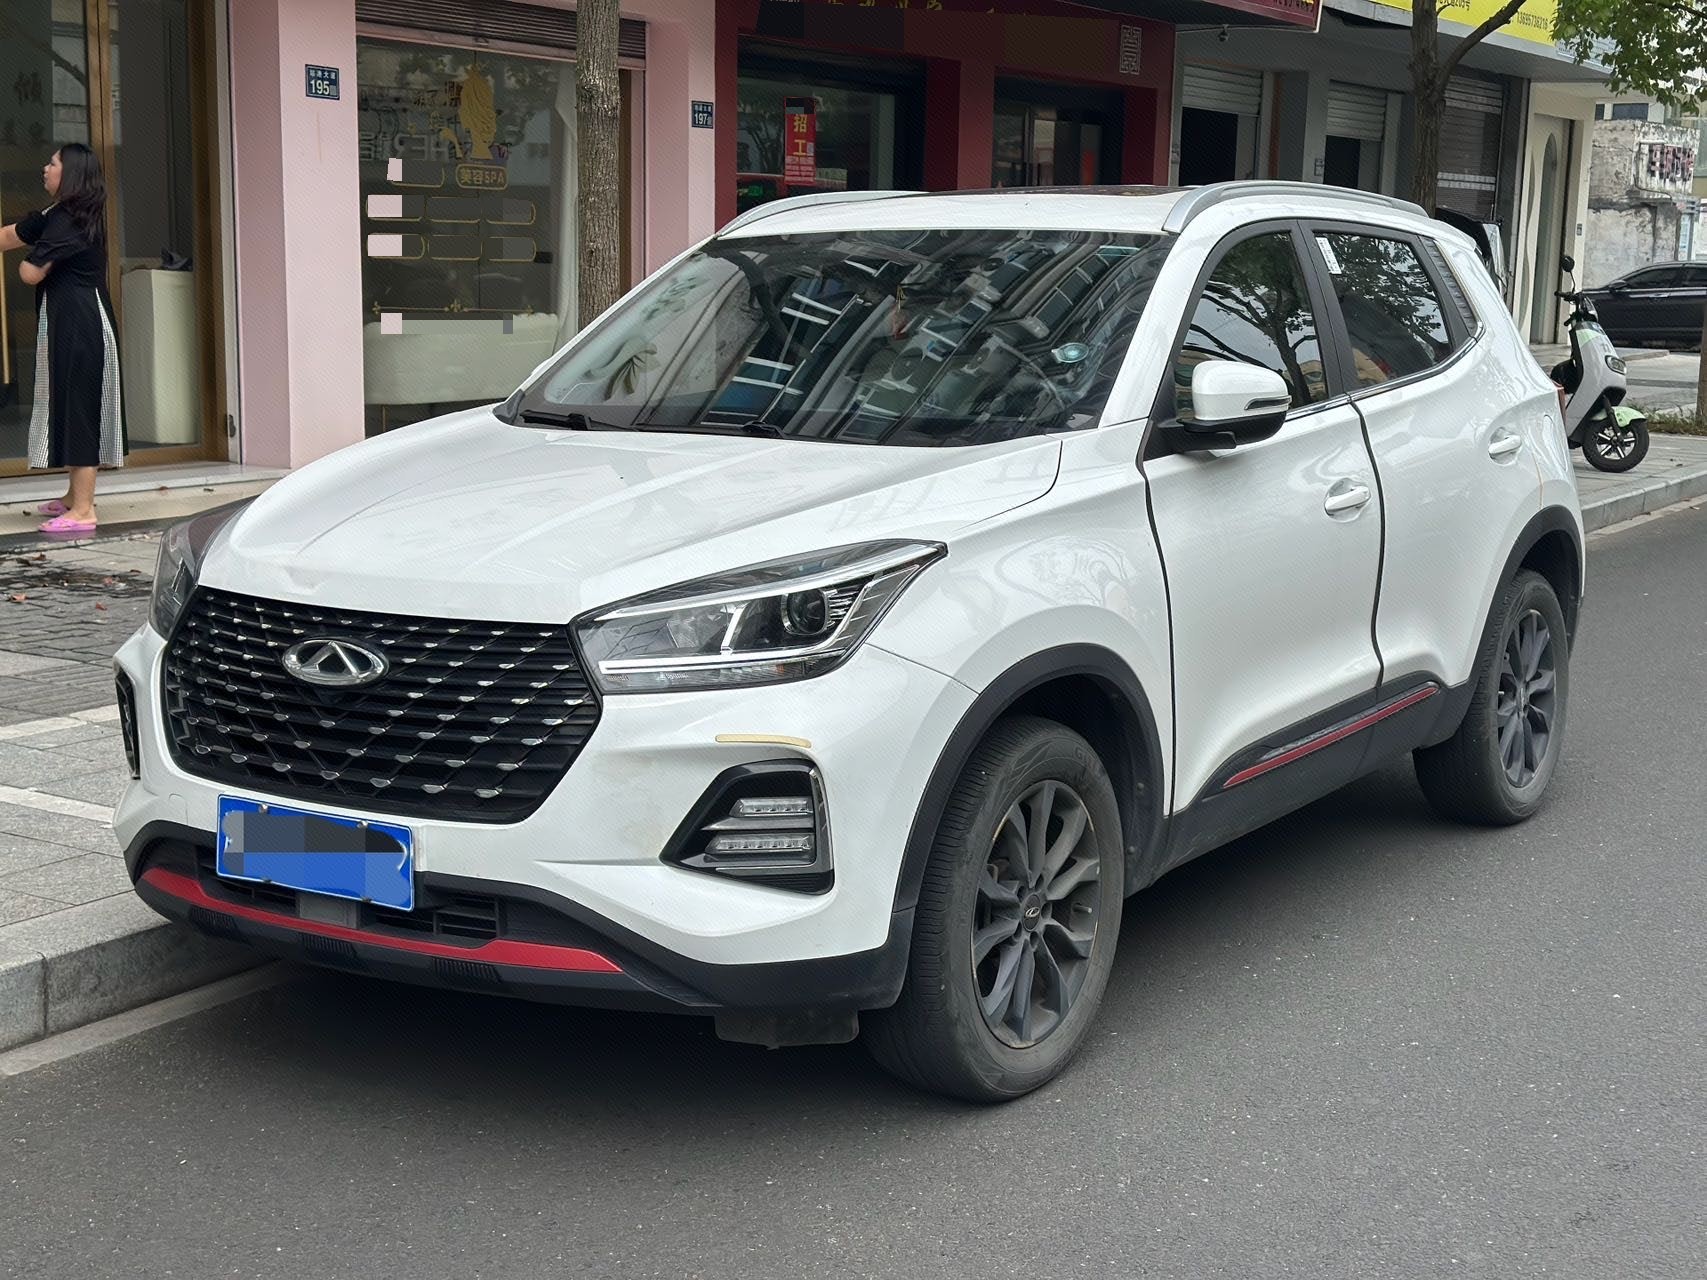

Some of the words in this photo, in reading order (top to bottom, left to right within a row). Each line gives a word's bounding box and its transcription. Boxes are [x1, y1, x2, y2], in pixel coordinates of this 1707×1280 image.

[310, 80, 330, 95] 195
[694, 112, 708, 125] 197
[793, 114, 808, 156] 招工
